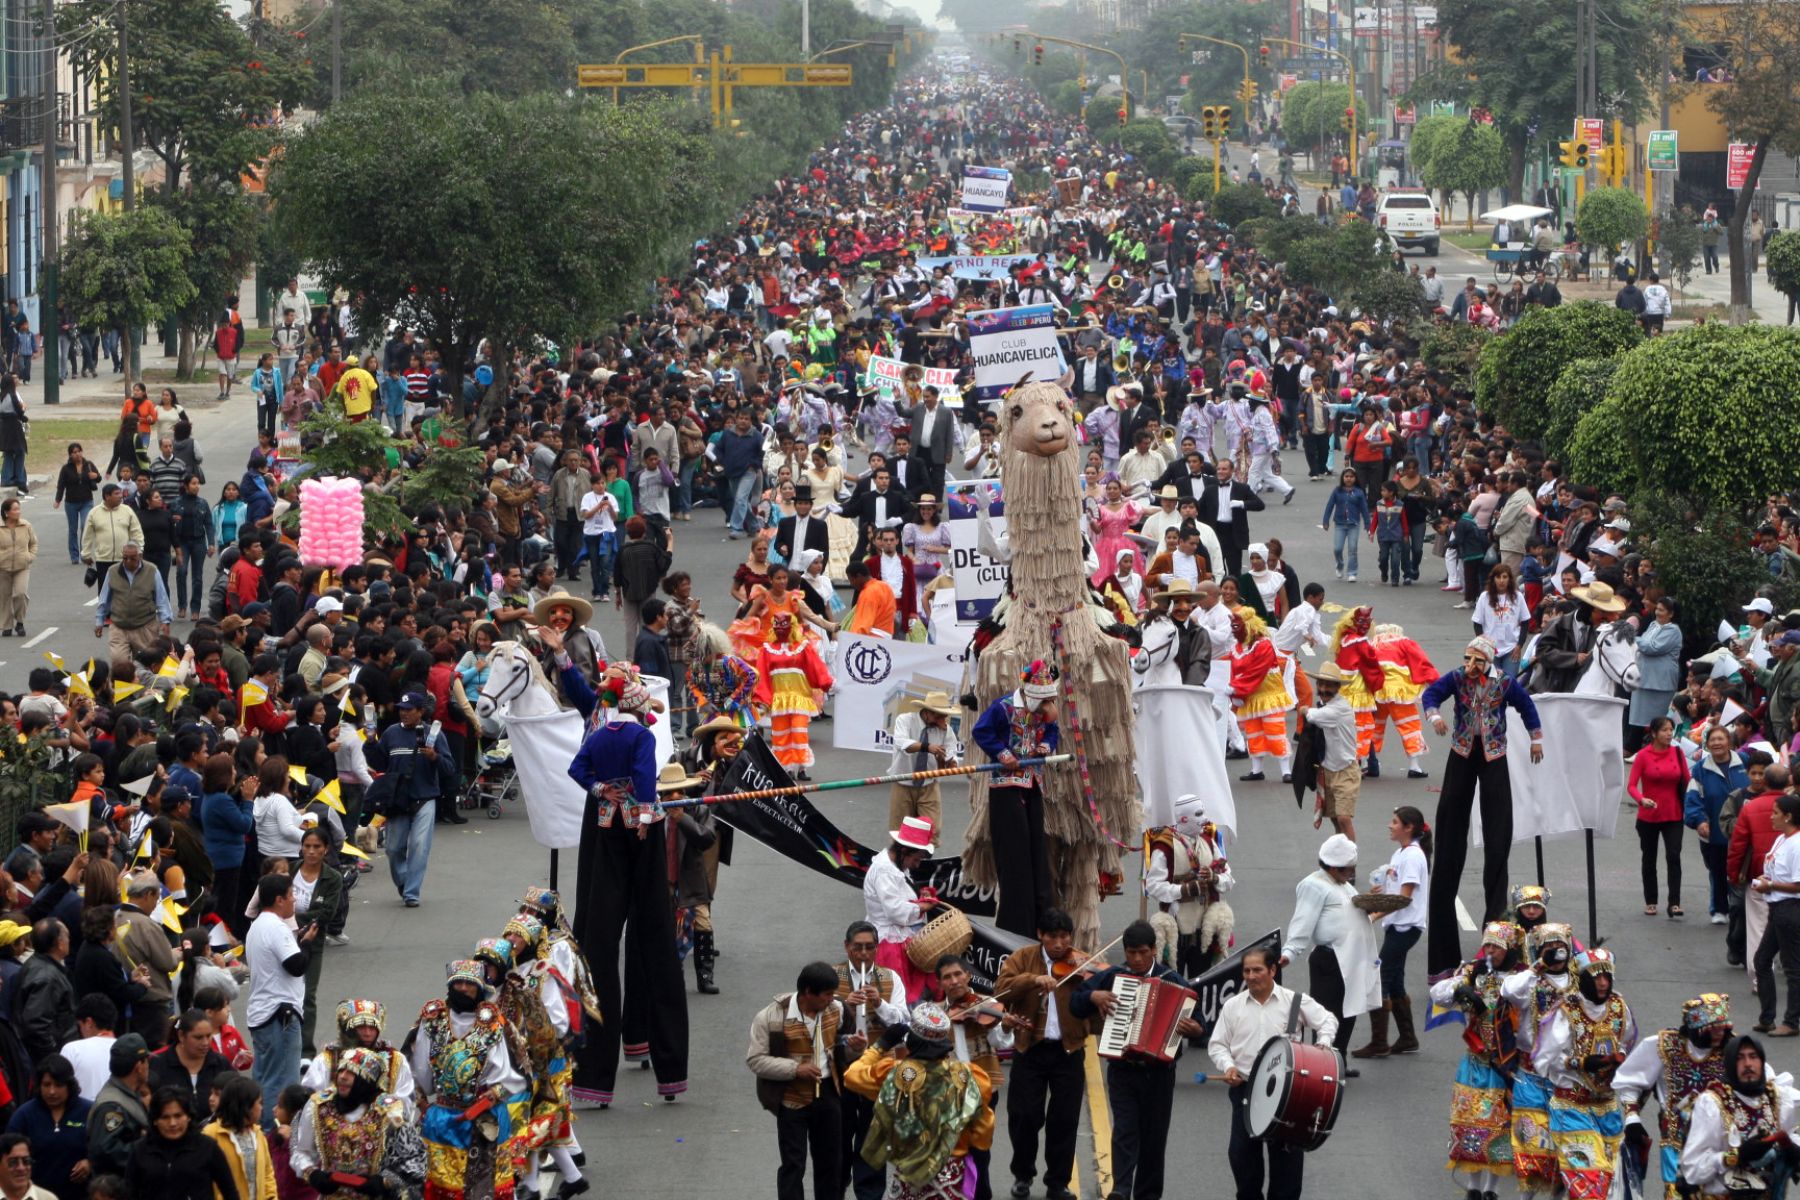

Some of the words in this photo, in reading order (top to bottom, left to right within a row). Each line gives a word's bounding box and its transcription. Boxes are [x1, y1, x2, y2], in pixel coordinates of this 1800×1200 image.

[965, 186, 1004, 198] HUANCAYO
[1001, 338, 1027, 349] CLUB
[973, 346, 1058, 368] HUANCAVELICA
